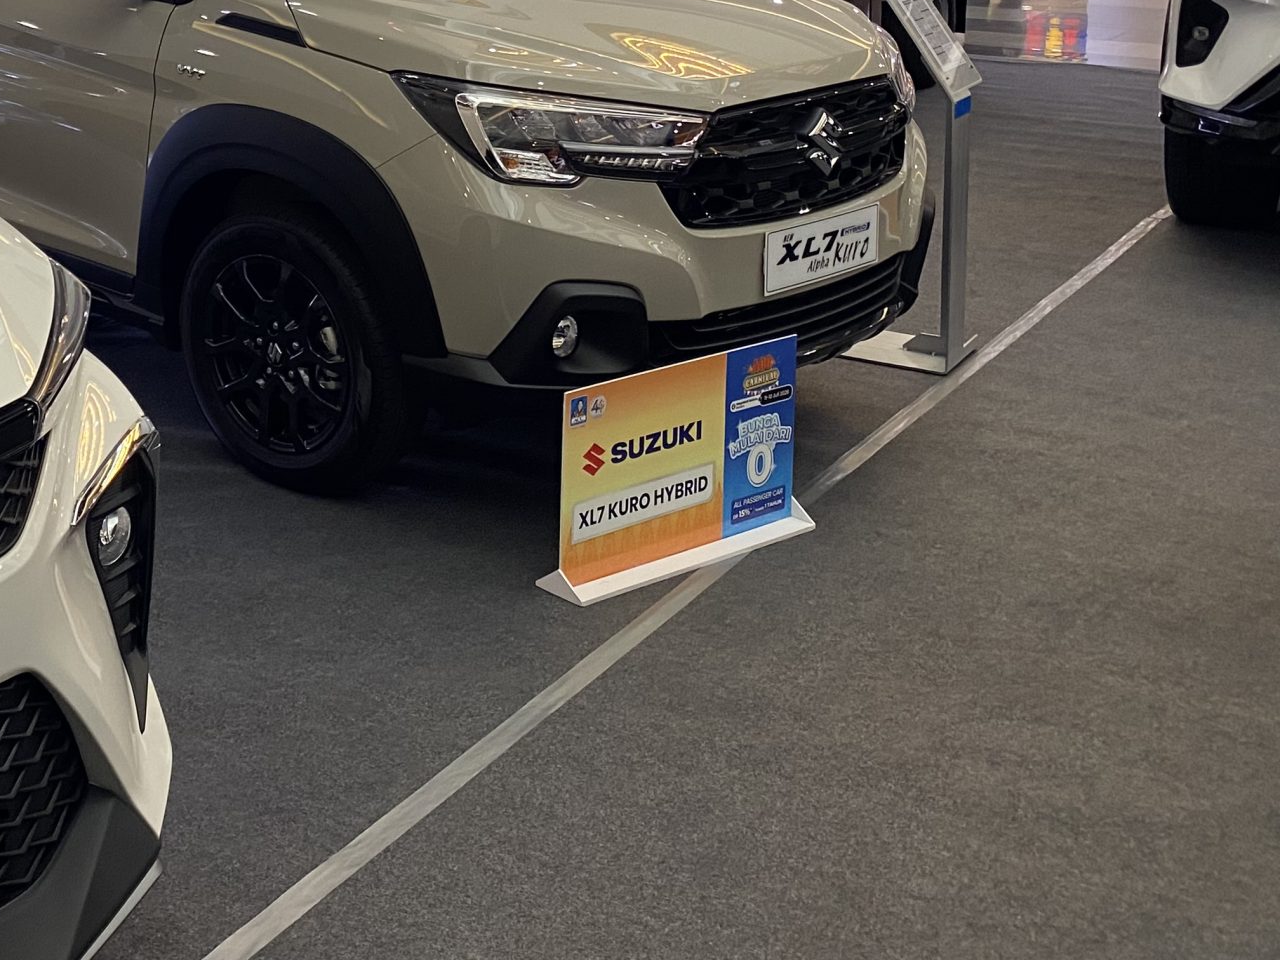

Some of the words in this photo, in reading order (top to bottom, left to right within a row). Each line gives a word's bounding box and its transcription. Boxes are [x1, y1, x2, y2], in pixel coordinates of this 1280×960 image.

[776, 229, 840, 266] XL7
[807, 257, 830, 273] Alpha
[832, 237, 870, 268] Kuro
[610, 420, 702, 464] SUZUKI
[729, 429, 764, 456] MULAI
[765, 427, 791, 442] DARI
[740, 414, 780, 436] BUNGA
[747, 442, 773, 487] 0
[578, 505, 605, 529] XL7
[608, 493, 651, 521] KURO
[654, 475, 708, 506] HYBRID
[733, 501, 742, 509] ALL
[743, 491, 772, 506] PASSENGER
[772, 487, 784, 497] CAR
